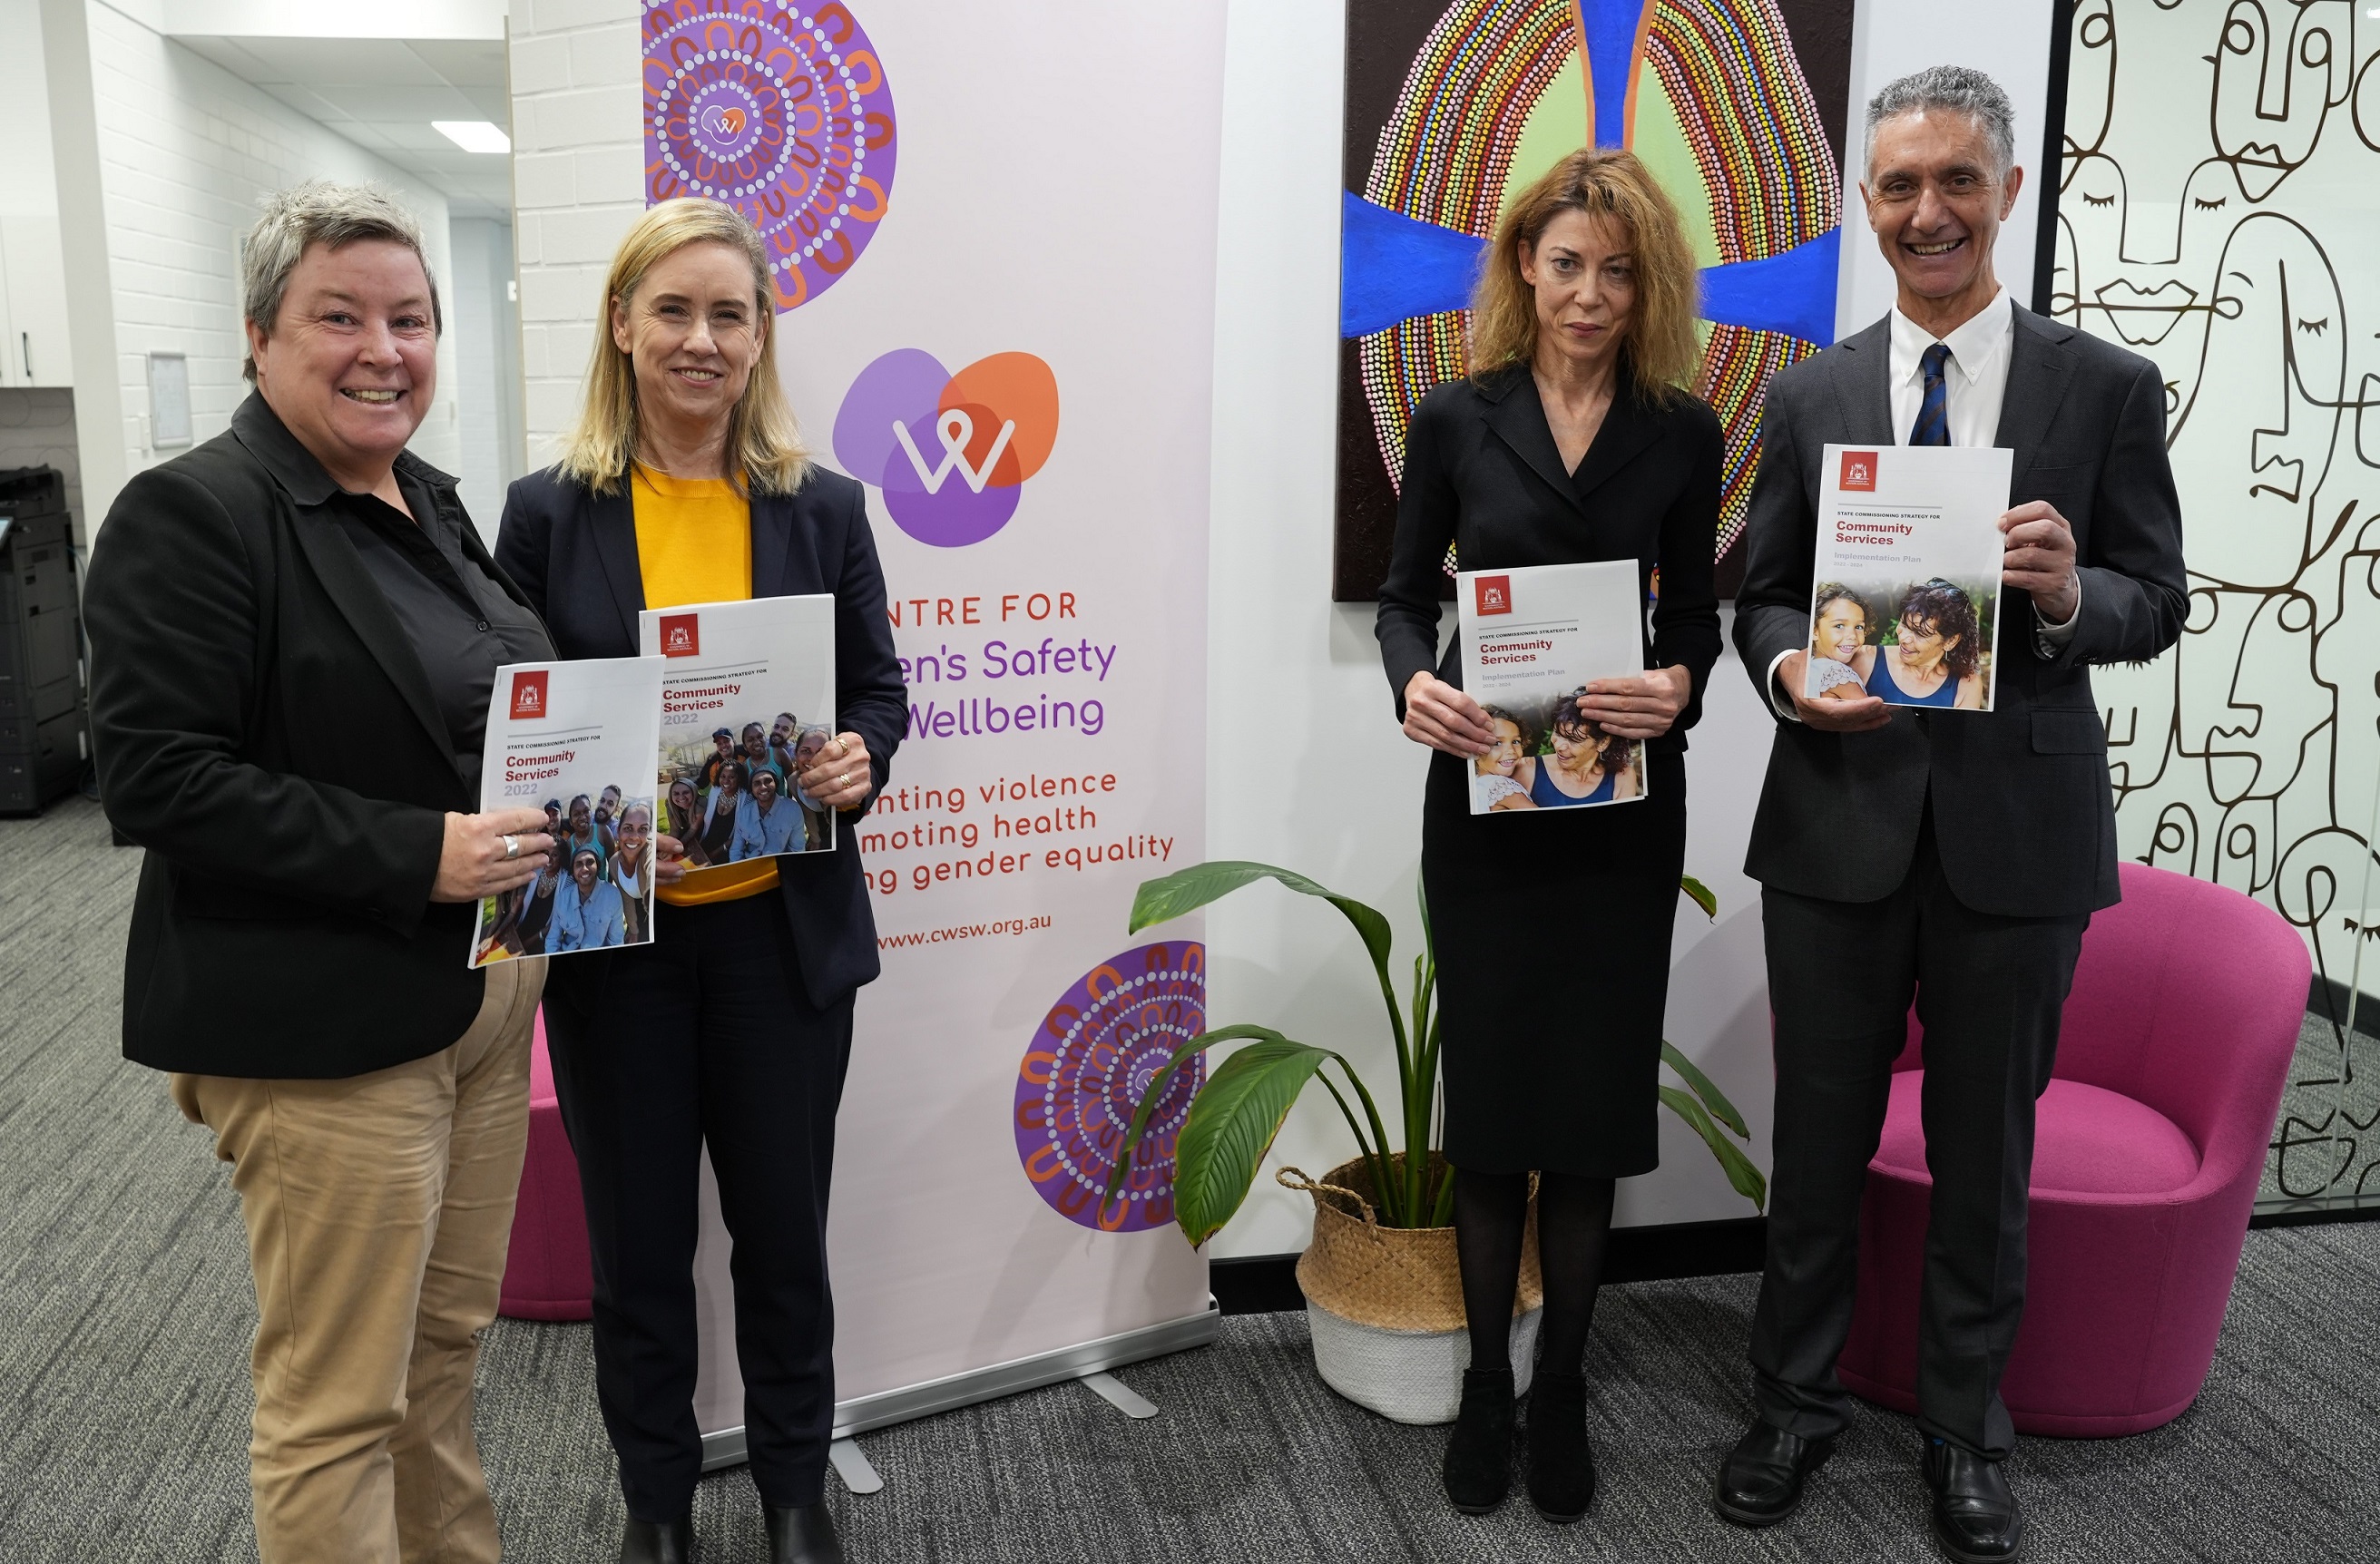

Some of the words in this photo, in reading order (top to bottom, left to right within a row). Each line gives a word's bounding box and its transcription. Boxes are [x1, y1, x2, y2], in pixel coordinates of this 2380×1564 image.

[1836, 521, 1913, 536] Community
[1836, 533, 1894, 545] Services
[1834, 552, 1900, 562] Implementation
[1002, 591, 1077, 622] FOR
[1480, 640, 1552, 653] Community
[983, 637, 1117, 682] Safety
[1481, 653, 1536, 665] Services
[681, 674, 727, 683] COMMISSIONING
[728, 670, 755, 679] STRATEGY
[1482, 670, 1545, 681] Implementation
[663, 683, 741, 699] Community
[663, 699, 724, 713] Services
[664, 713, 698, 726] 2022
[902, 693, 1104, 740] Wellbeing
[525, 739, 565, 748] COMMISSIONING
[506, 750, 575, 767] Community
[505, 767, 559, 782] Services
[504, 783, 538, 797] 2022
[865, 785, 965, 816] nting
[979, 773, 1117, 804] violence
[861, 816, 979, 854] moting
[994, 805, 1097, 839] health
[913, 851, 1031, 891] gender
[1045, 834, 1173, 872] equality
[877, 914, 1051, 951] www.cwsw.org.au
